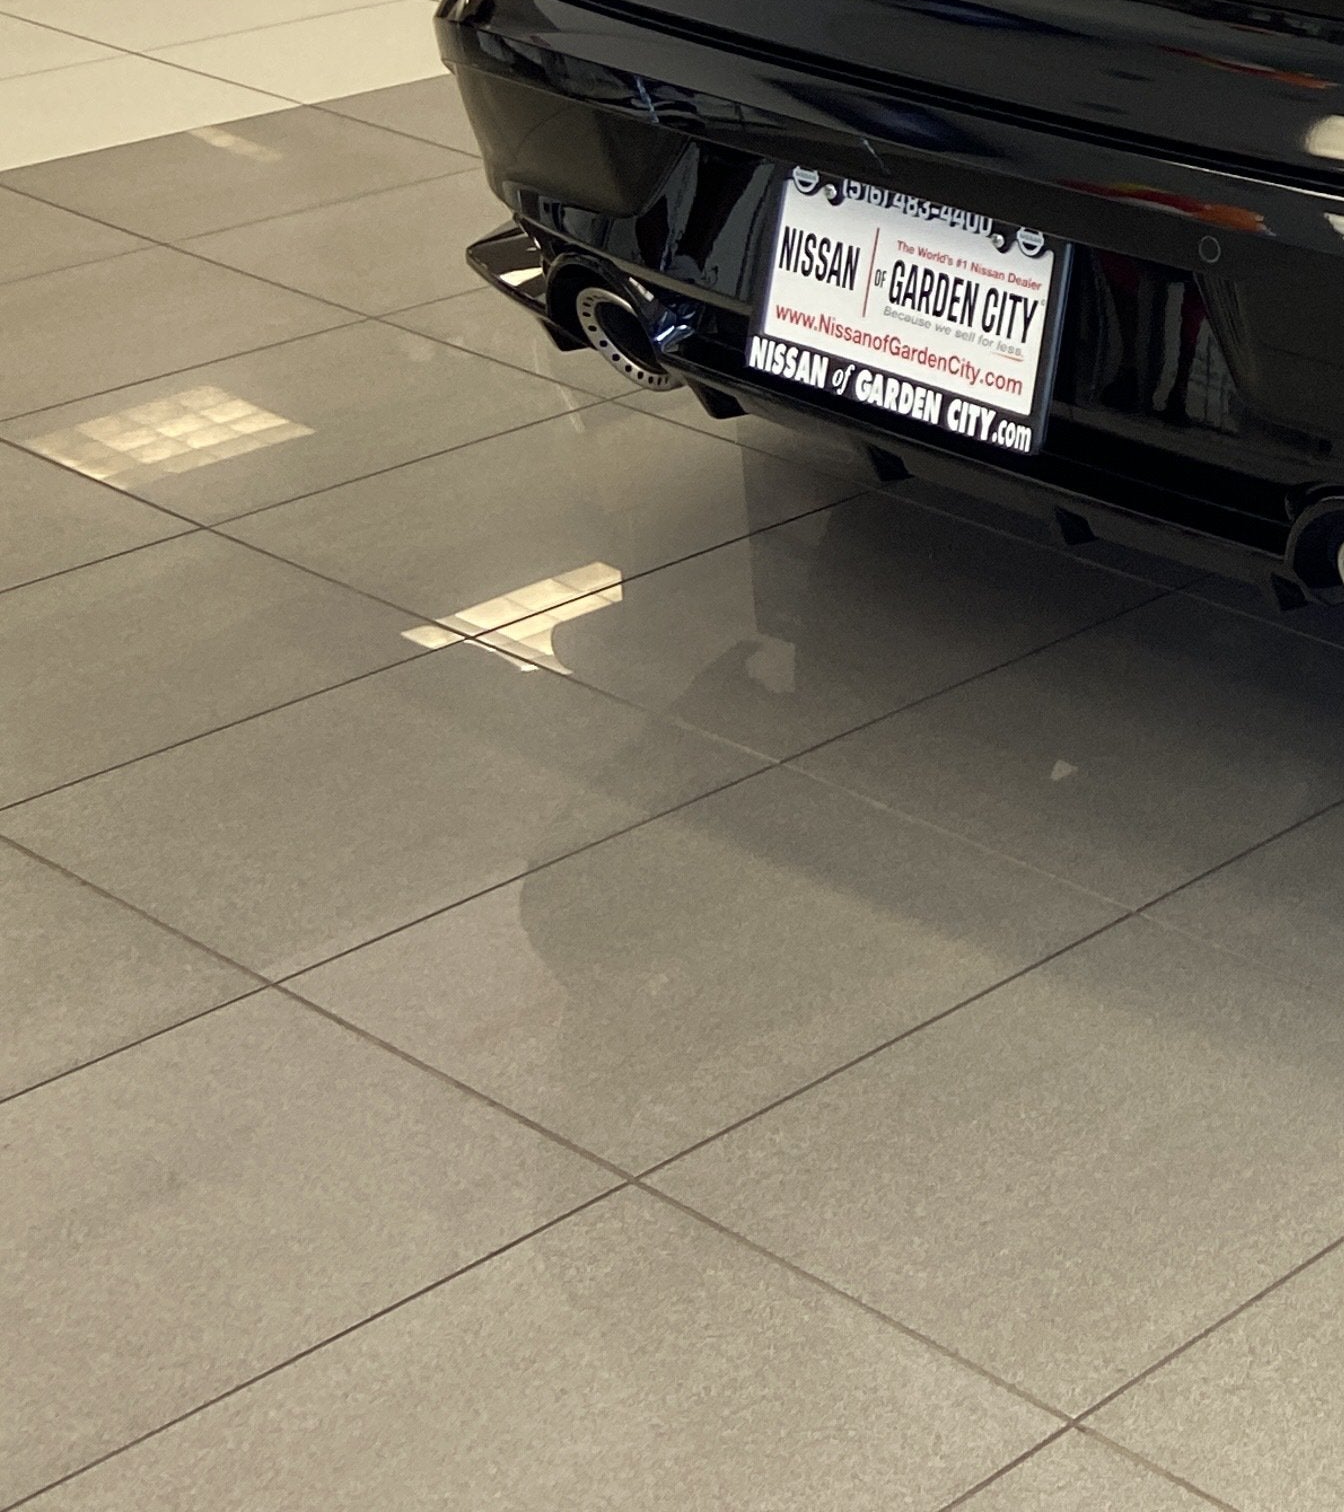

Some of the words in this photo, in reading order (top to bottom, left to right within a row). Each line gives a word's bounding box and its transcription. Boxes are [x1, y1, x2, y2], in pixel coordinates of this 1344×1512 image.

[778, 225, 860, 292] NISSAN
[874, 268, 888, 289] OF
[888, 259, 980, 328] GARDEN
[981, 287, 1039, 344] CITY
[897, 240, 916, 255] The
[917, 246, 954, 267] World's
[955, 258, 968, 270] #1
[970, 262, 1005, 281] Nissan
[1007, 272, 1043, 291] Dealer
[775, 304, 1023, 396] www.NissanofGardenCity.com
[883, 305, 932, 330] Because
[935, 323, 952, 336] we
[954, 328, 976, 344] sell
[977, 334, 995, 350] for
[996, 339, 1024, 357] less.
[749, 335, 830, 389] NISSAN
[831, 364, 856, 396] of
[855, 368, 943, 426] GARDEN
[946, 398, 1033, 454] CITY.com
